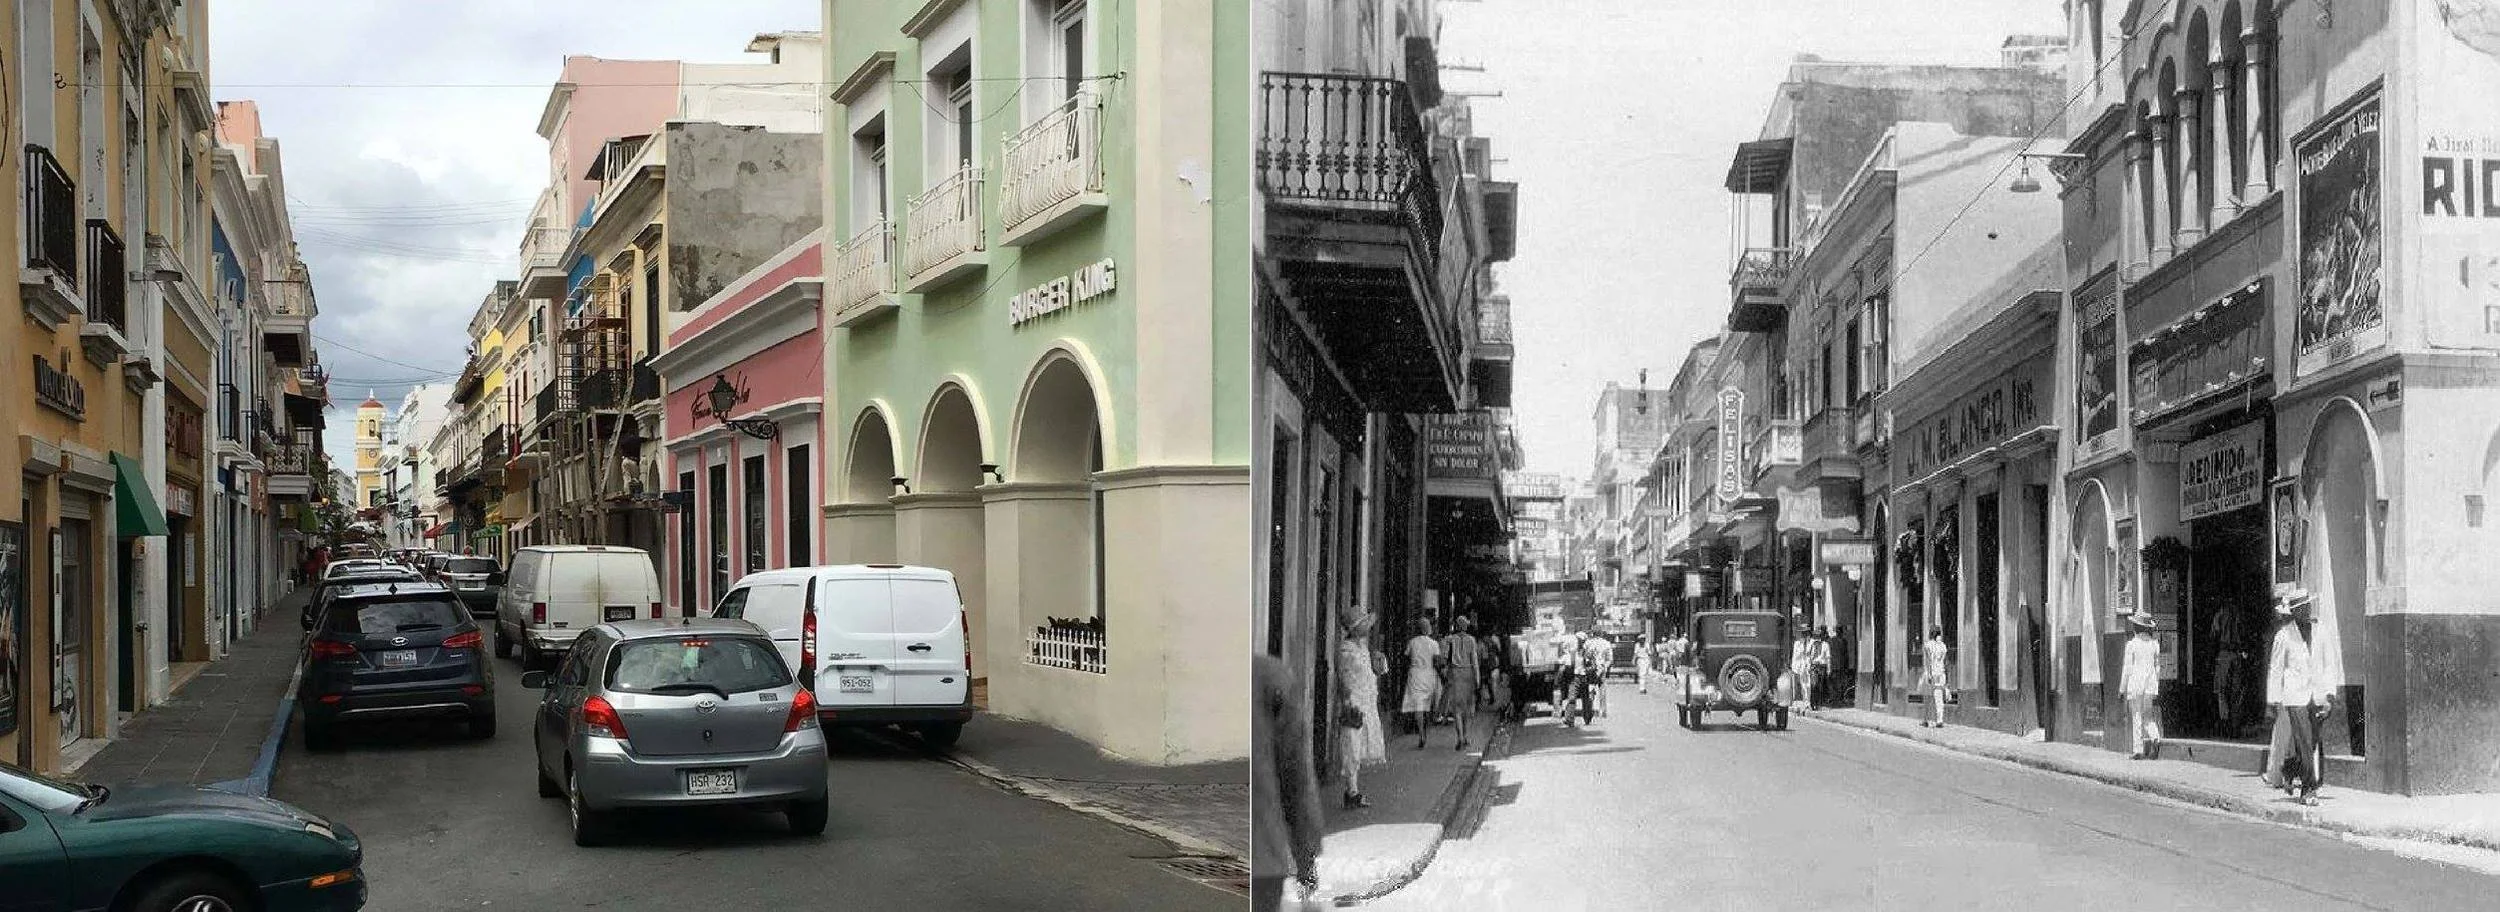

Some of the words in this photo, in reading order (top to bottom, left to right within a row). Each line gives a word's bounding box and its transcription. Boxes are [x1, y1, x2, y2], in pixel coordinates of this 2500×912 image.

[1009, 275, 1070, 326] BURGER
[1074, 258, 1117, 302] KING
[842, 679, 871, 688] 951-052
[715, 774, 733, 787] 232
